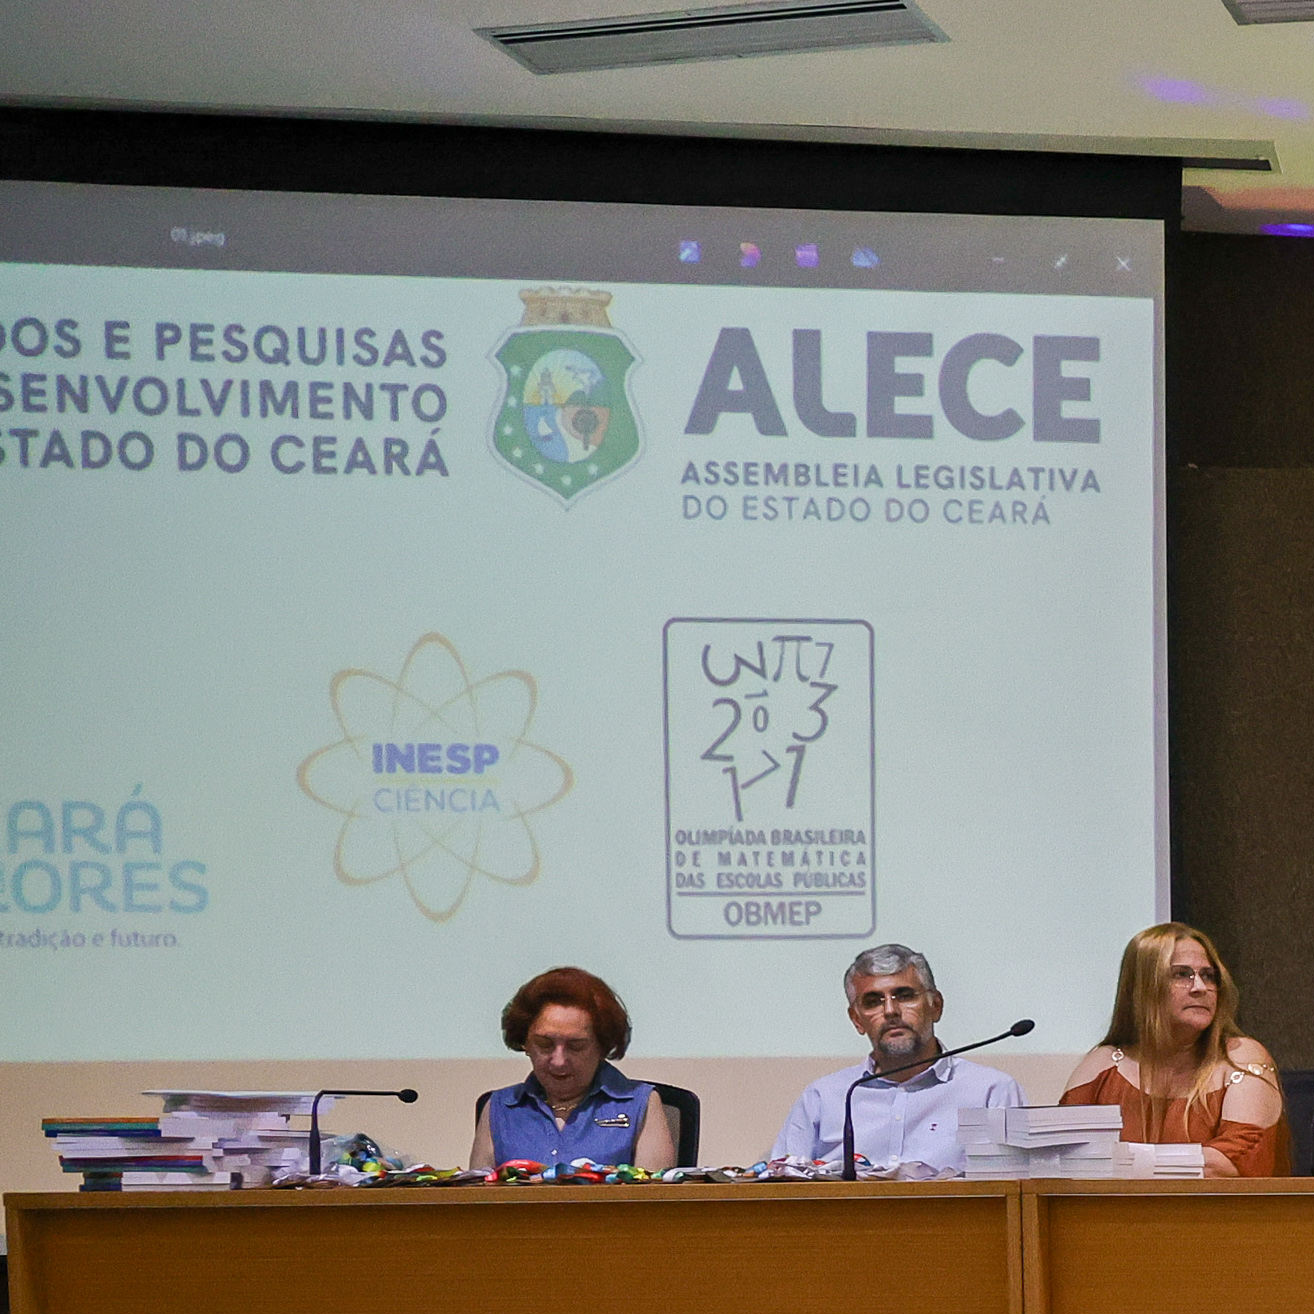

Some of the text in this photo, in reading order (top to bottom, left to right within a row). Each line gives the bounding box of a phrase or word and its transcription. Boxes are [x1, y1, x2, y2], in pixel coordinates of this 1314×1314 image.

[0, 316, 448, 369] OS E PESQUISAS
[683, 326, 1101, 444] ALECE
[0, 427, 450, 477] TADO DO CEARÁ
[681, 460, 1101, 493] ASSEMBLEIA LEGISLATIVA
[682, 494, 1051, 525] DO ESTADO DO CEARÁ
[372, 742, 500, 774] INESP
[373, 784, 500, 813] CIÊNCIA
[6, 782, 162, 854] ARÁ
[675, 825, 866, 845] OLIMPÍADA BRASILEIRA
[0, 859, 210, 914] ORES
[675, 868, 866, 889] DAS ESCOLAS PÚBLICAS
[723, 900, 822, 927] OBMEP
[92, 932, 104, 947] e
